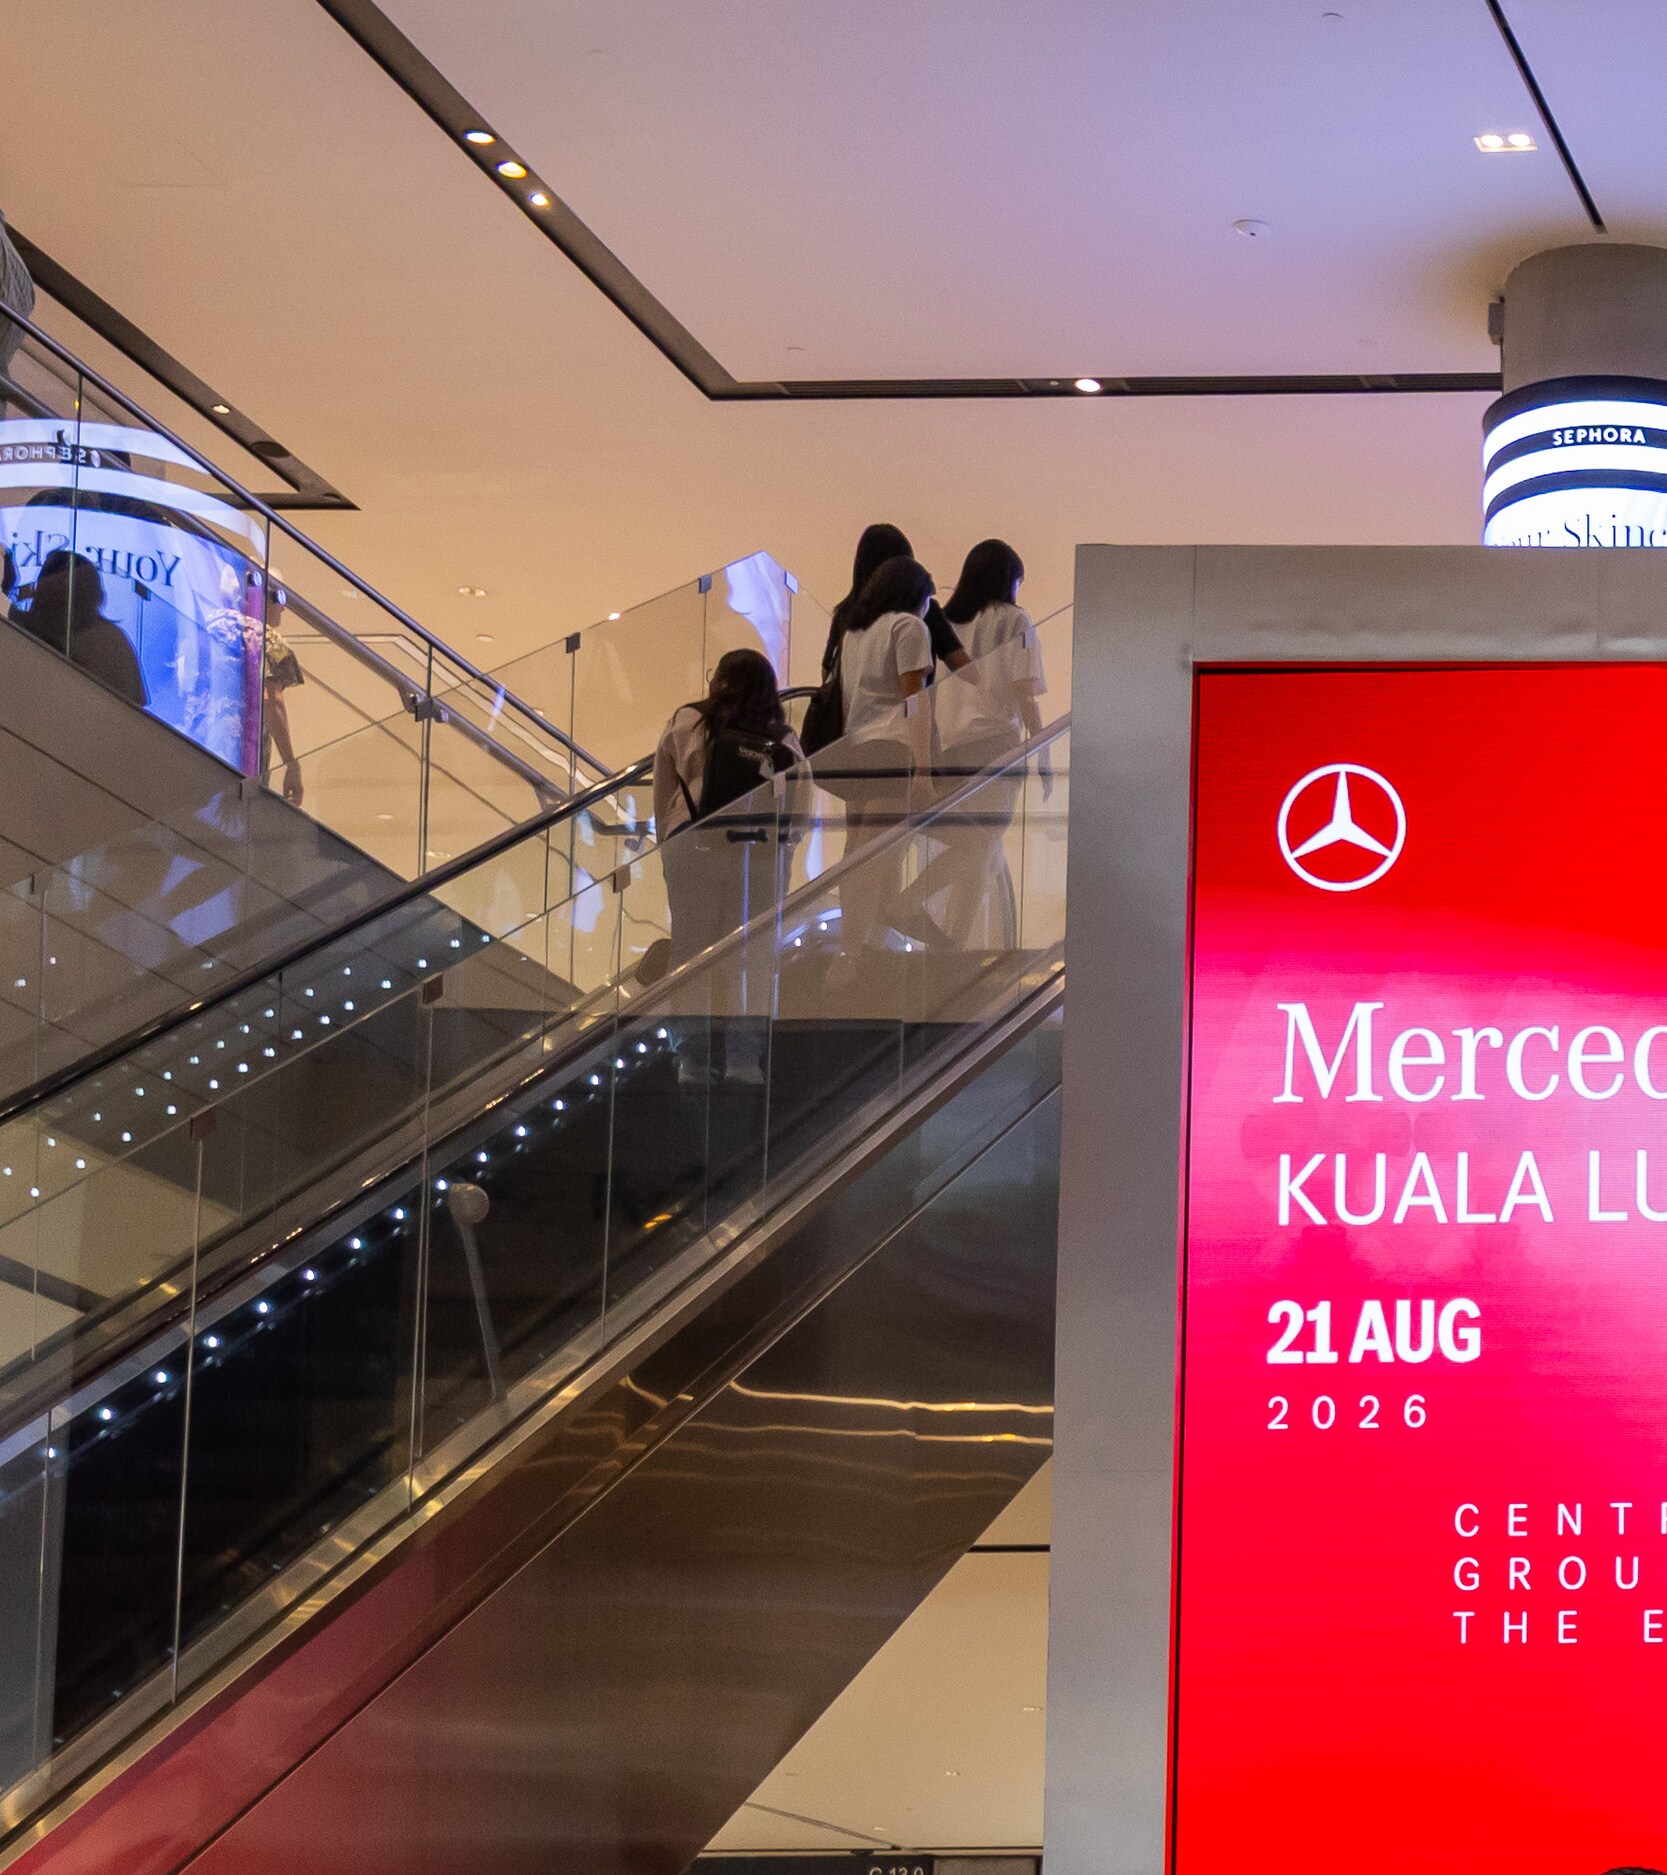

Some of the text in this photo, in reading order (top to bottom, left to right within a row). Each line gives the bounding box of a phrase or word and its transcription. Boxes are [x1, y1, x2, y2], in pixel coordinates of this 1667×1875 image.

[1552, 427, 1647, 446] SEPHORA
[1279, 1150, 1554, 1225] KUALA
[1267, 1298, 1481, 1364] 21 AUG
[1268, 1394, 1426, 1430] 2026
[1454, 1610, 1577, 1644] THE
